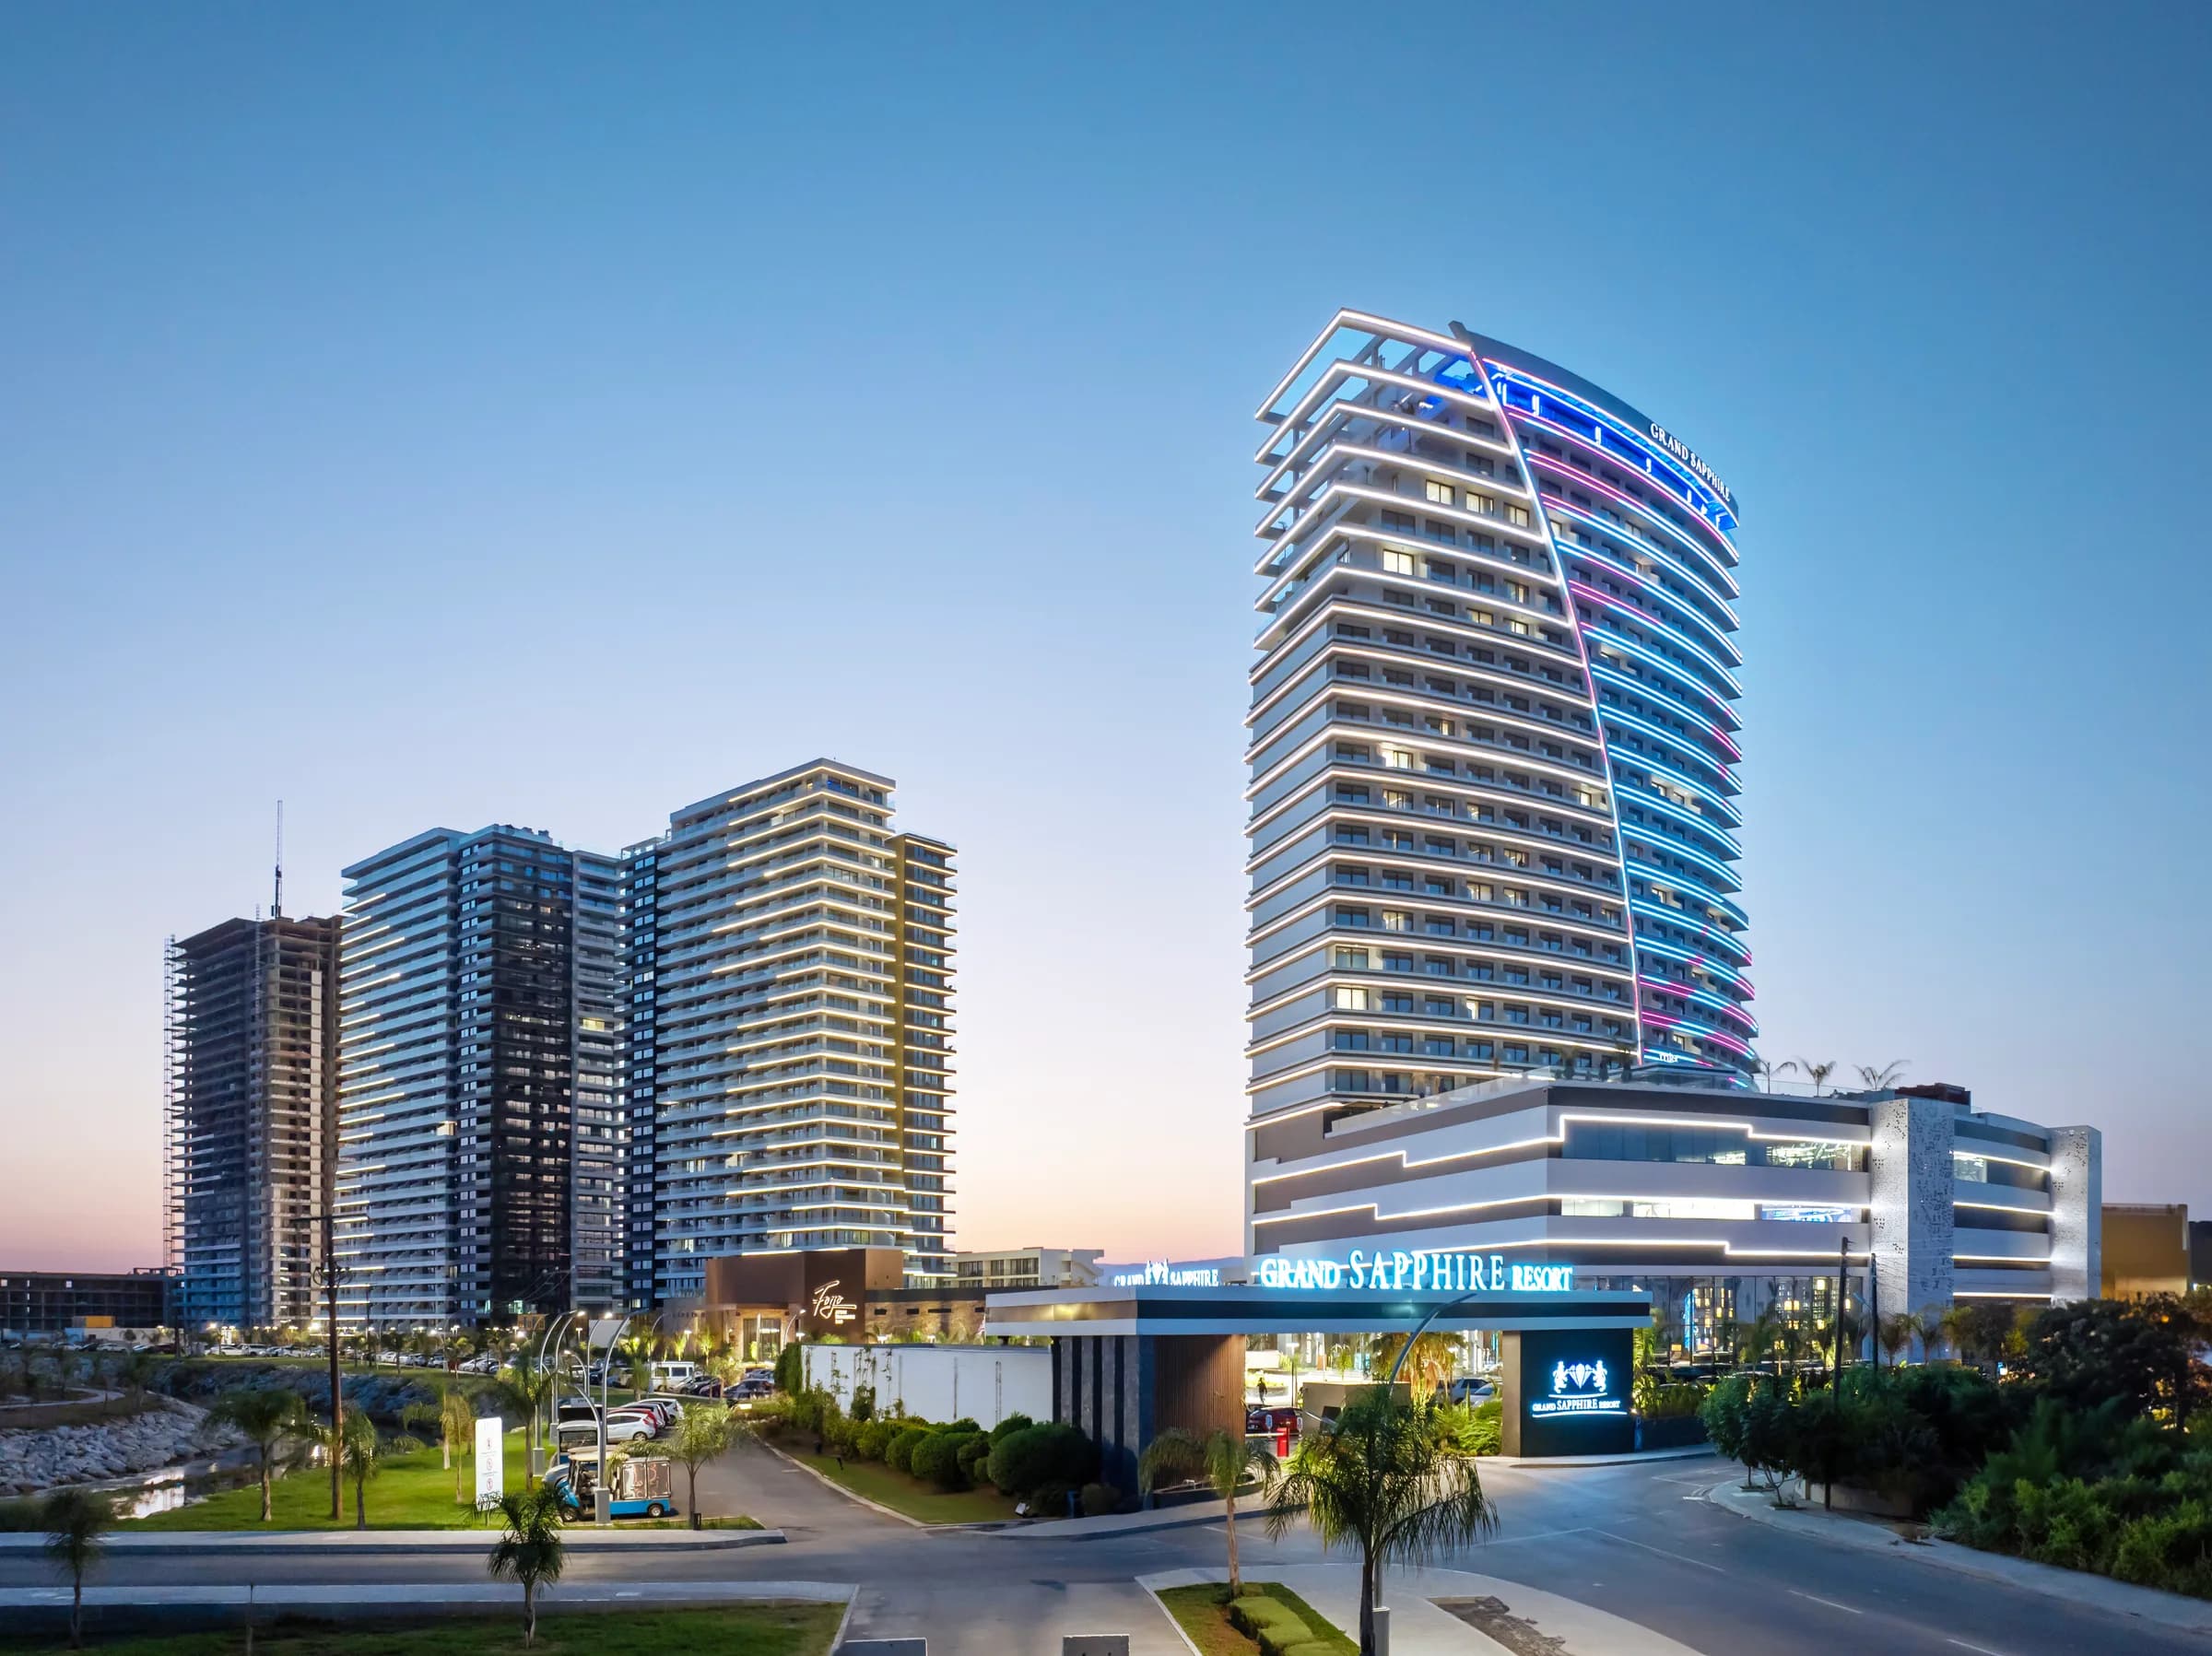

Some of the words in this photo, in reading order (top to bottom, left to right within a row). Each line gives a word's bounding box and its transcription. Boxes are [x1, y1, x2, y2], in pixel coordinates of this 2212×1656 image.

[1650, 423, 1688, 460] GRAND
[1690, 452, 1731, 501] SAPPHIRE
[1170, 1269, 1219, 1286] SAPPHIRE
[1260, 1258, 1340, 1288] GRAND
[1348, 1250, 1505, 1290] SAPPHIRE
[1512, 1265, 1572, 1290] RESORT
[1557, 1399, 1598, 1410] SAPPHIRE
